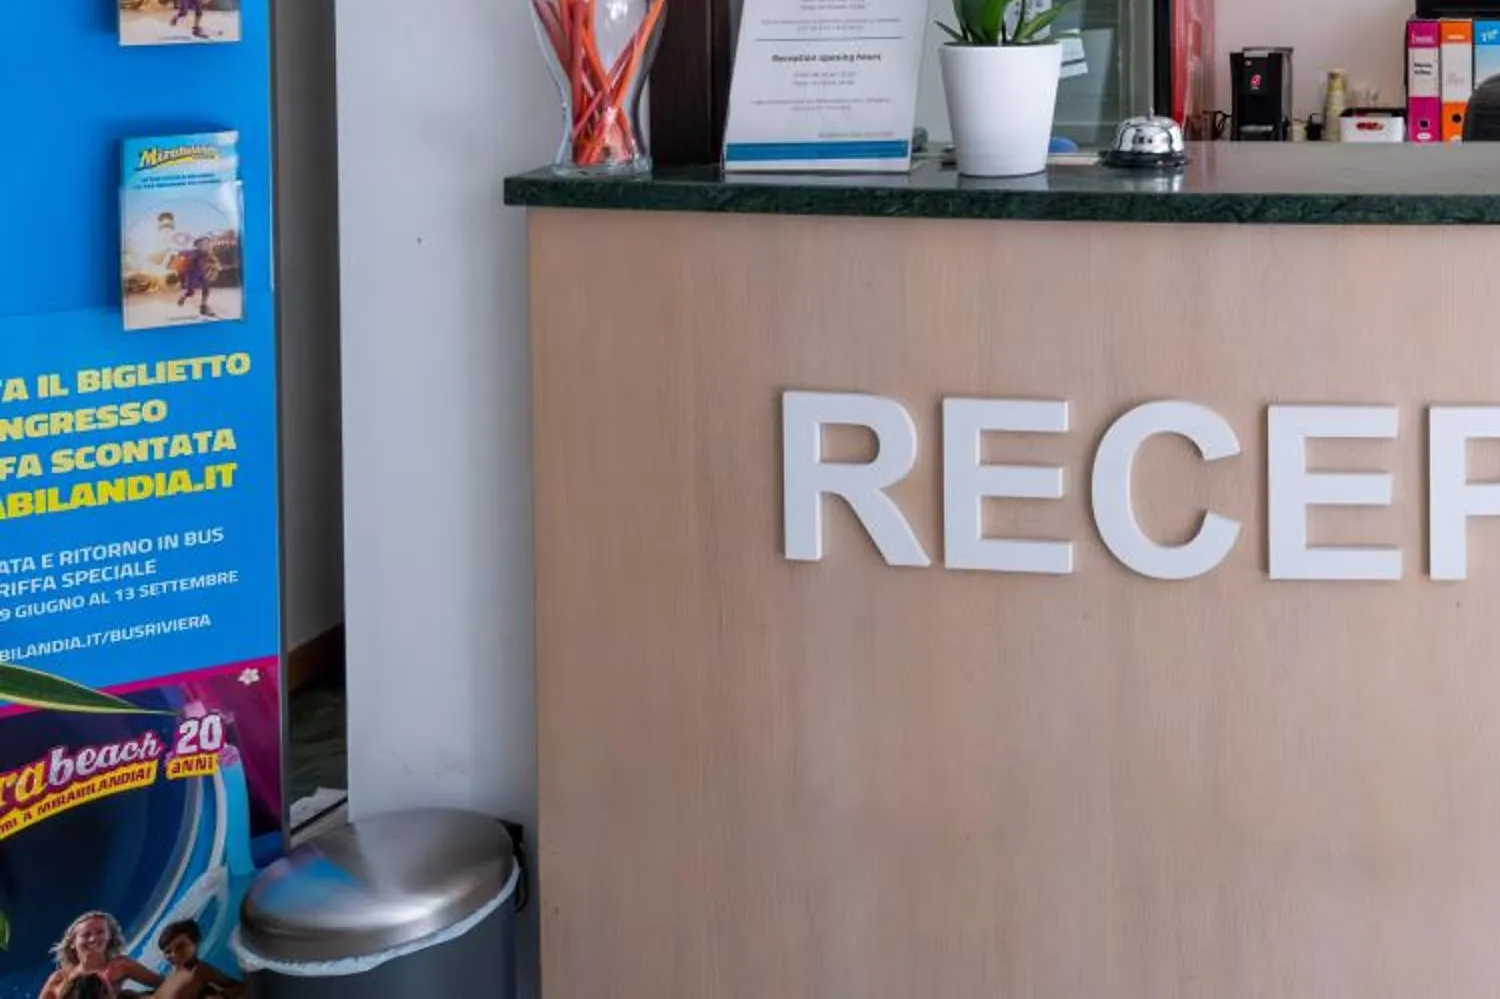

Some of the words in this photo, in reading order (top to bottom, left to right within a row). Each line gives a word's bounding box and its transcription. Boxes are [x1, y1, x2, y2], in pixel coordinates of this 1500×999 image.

[0, 377, 29, 402] A
[37, 373, 69, 398] IL
[77, 352, 251, 394] BIGLIETTO
[51, 428, 237, 474] SCONTATA
[41, 552, 54, 569] E
[59, 538, 153, 566] RITORNO
[157, 534, 179, 551] IN
[183, 526, 225, 546] BUS
[15, 595, 85, 618] GIUGNO
[89, 591, 110, 606] AL
[115, 587, 136, 601] 13
[139, 570, 240, 598] SETTEMBRE
[61, 558, 157, 589] SPECIALE
[176, 713, 223, 753] 20
